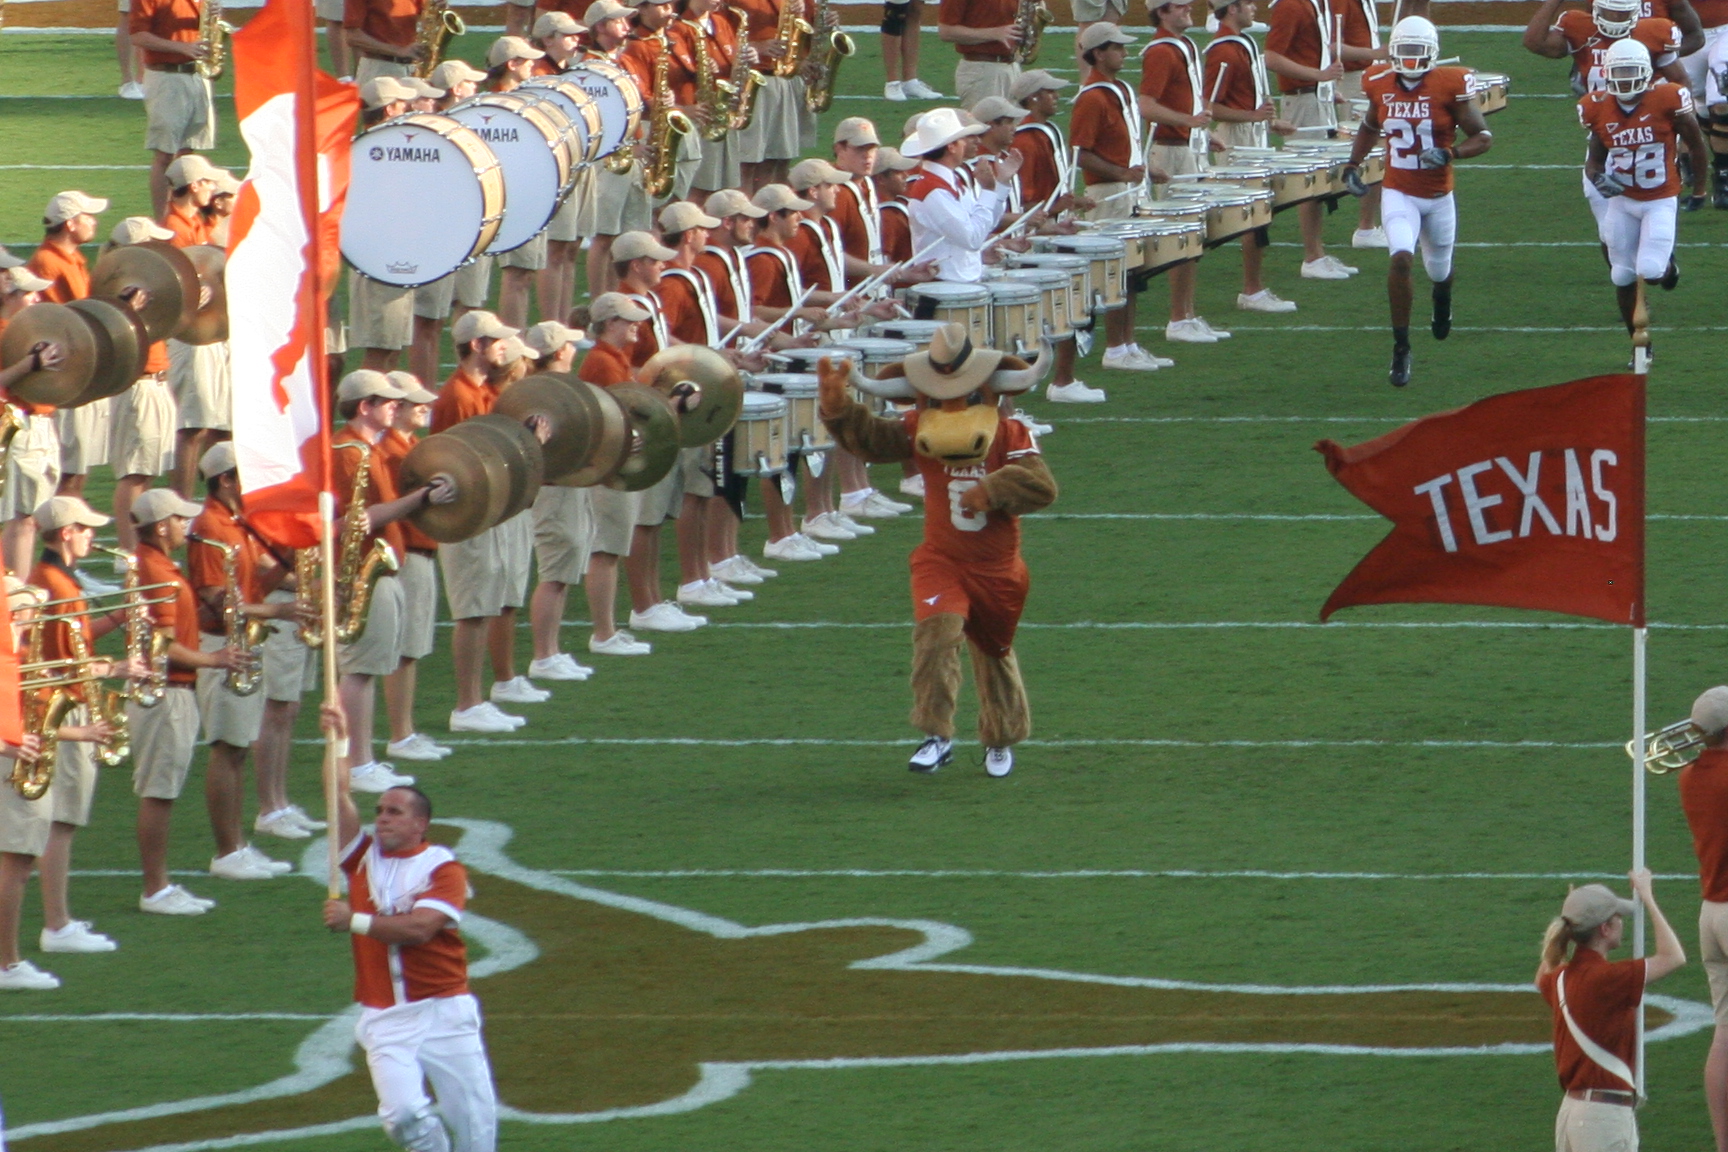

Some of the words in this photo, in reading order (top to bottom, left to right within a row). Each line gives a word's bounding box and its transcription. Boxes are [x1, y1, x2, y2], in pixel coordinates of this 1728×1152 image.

[1386, 101, 1430, 119] TEXAS
[470, 128, 519, 143] AMAHA
[1382, 120, 1434, 170] 21
[1611, 126, 1654, 146] TEXAS
[386, 147, 441, 163] YAMAHA
[1609, 142, 1667, 189] 28
[1412, 447, 1619, 553] TEXAS
